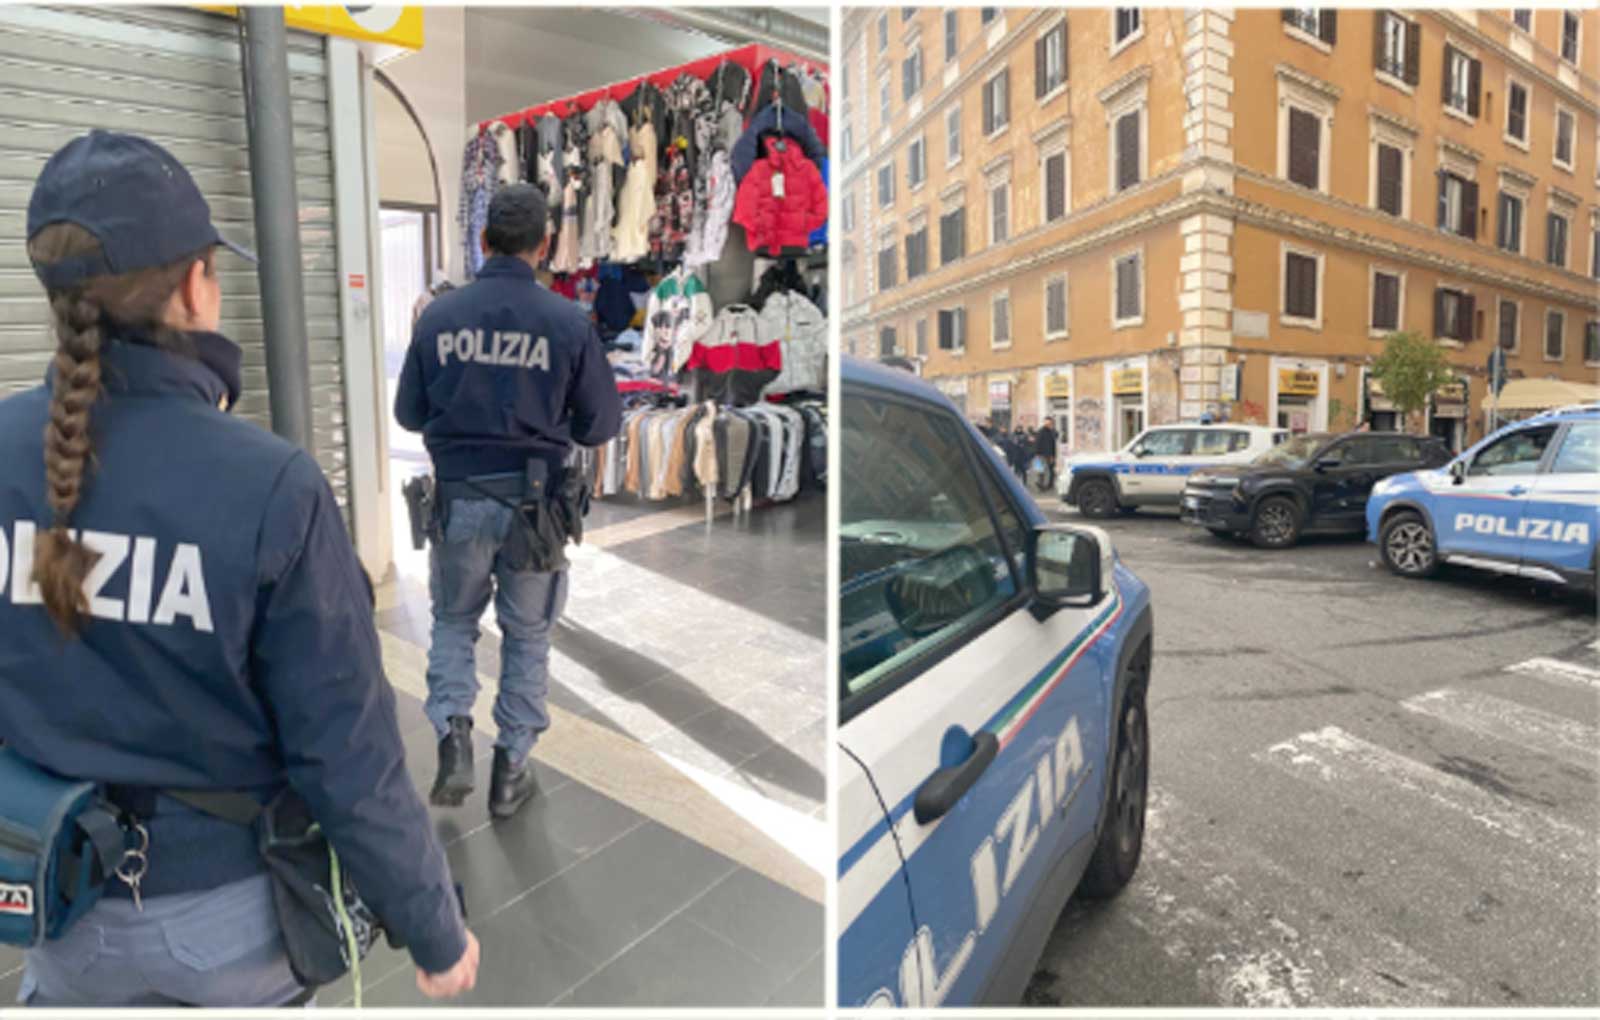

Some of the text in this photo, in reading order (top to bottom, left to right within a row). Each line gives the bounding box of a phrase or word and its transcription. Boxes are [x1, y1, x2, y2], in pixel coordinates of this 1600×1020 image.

[437, 328, 550, 371] POLIZIA
[1454, 513, 1590, 545] POLIZIA
[0, 520, 214, 633] LZIA
[861, 713, 1084, 1008] LIZIA
